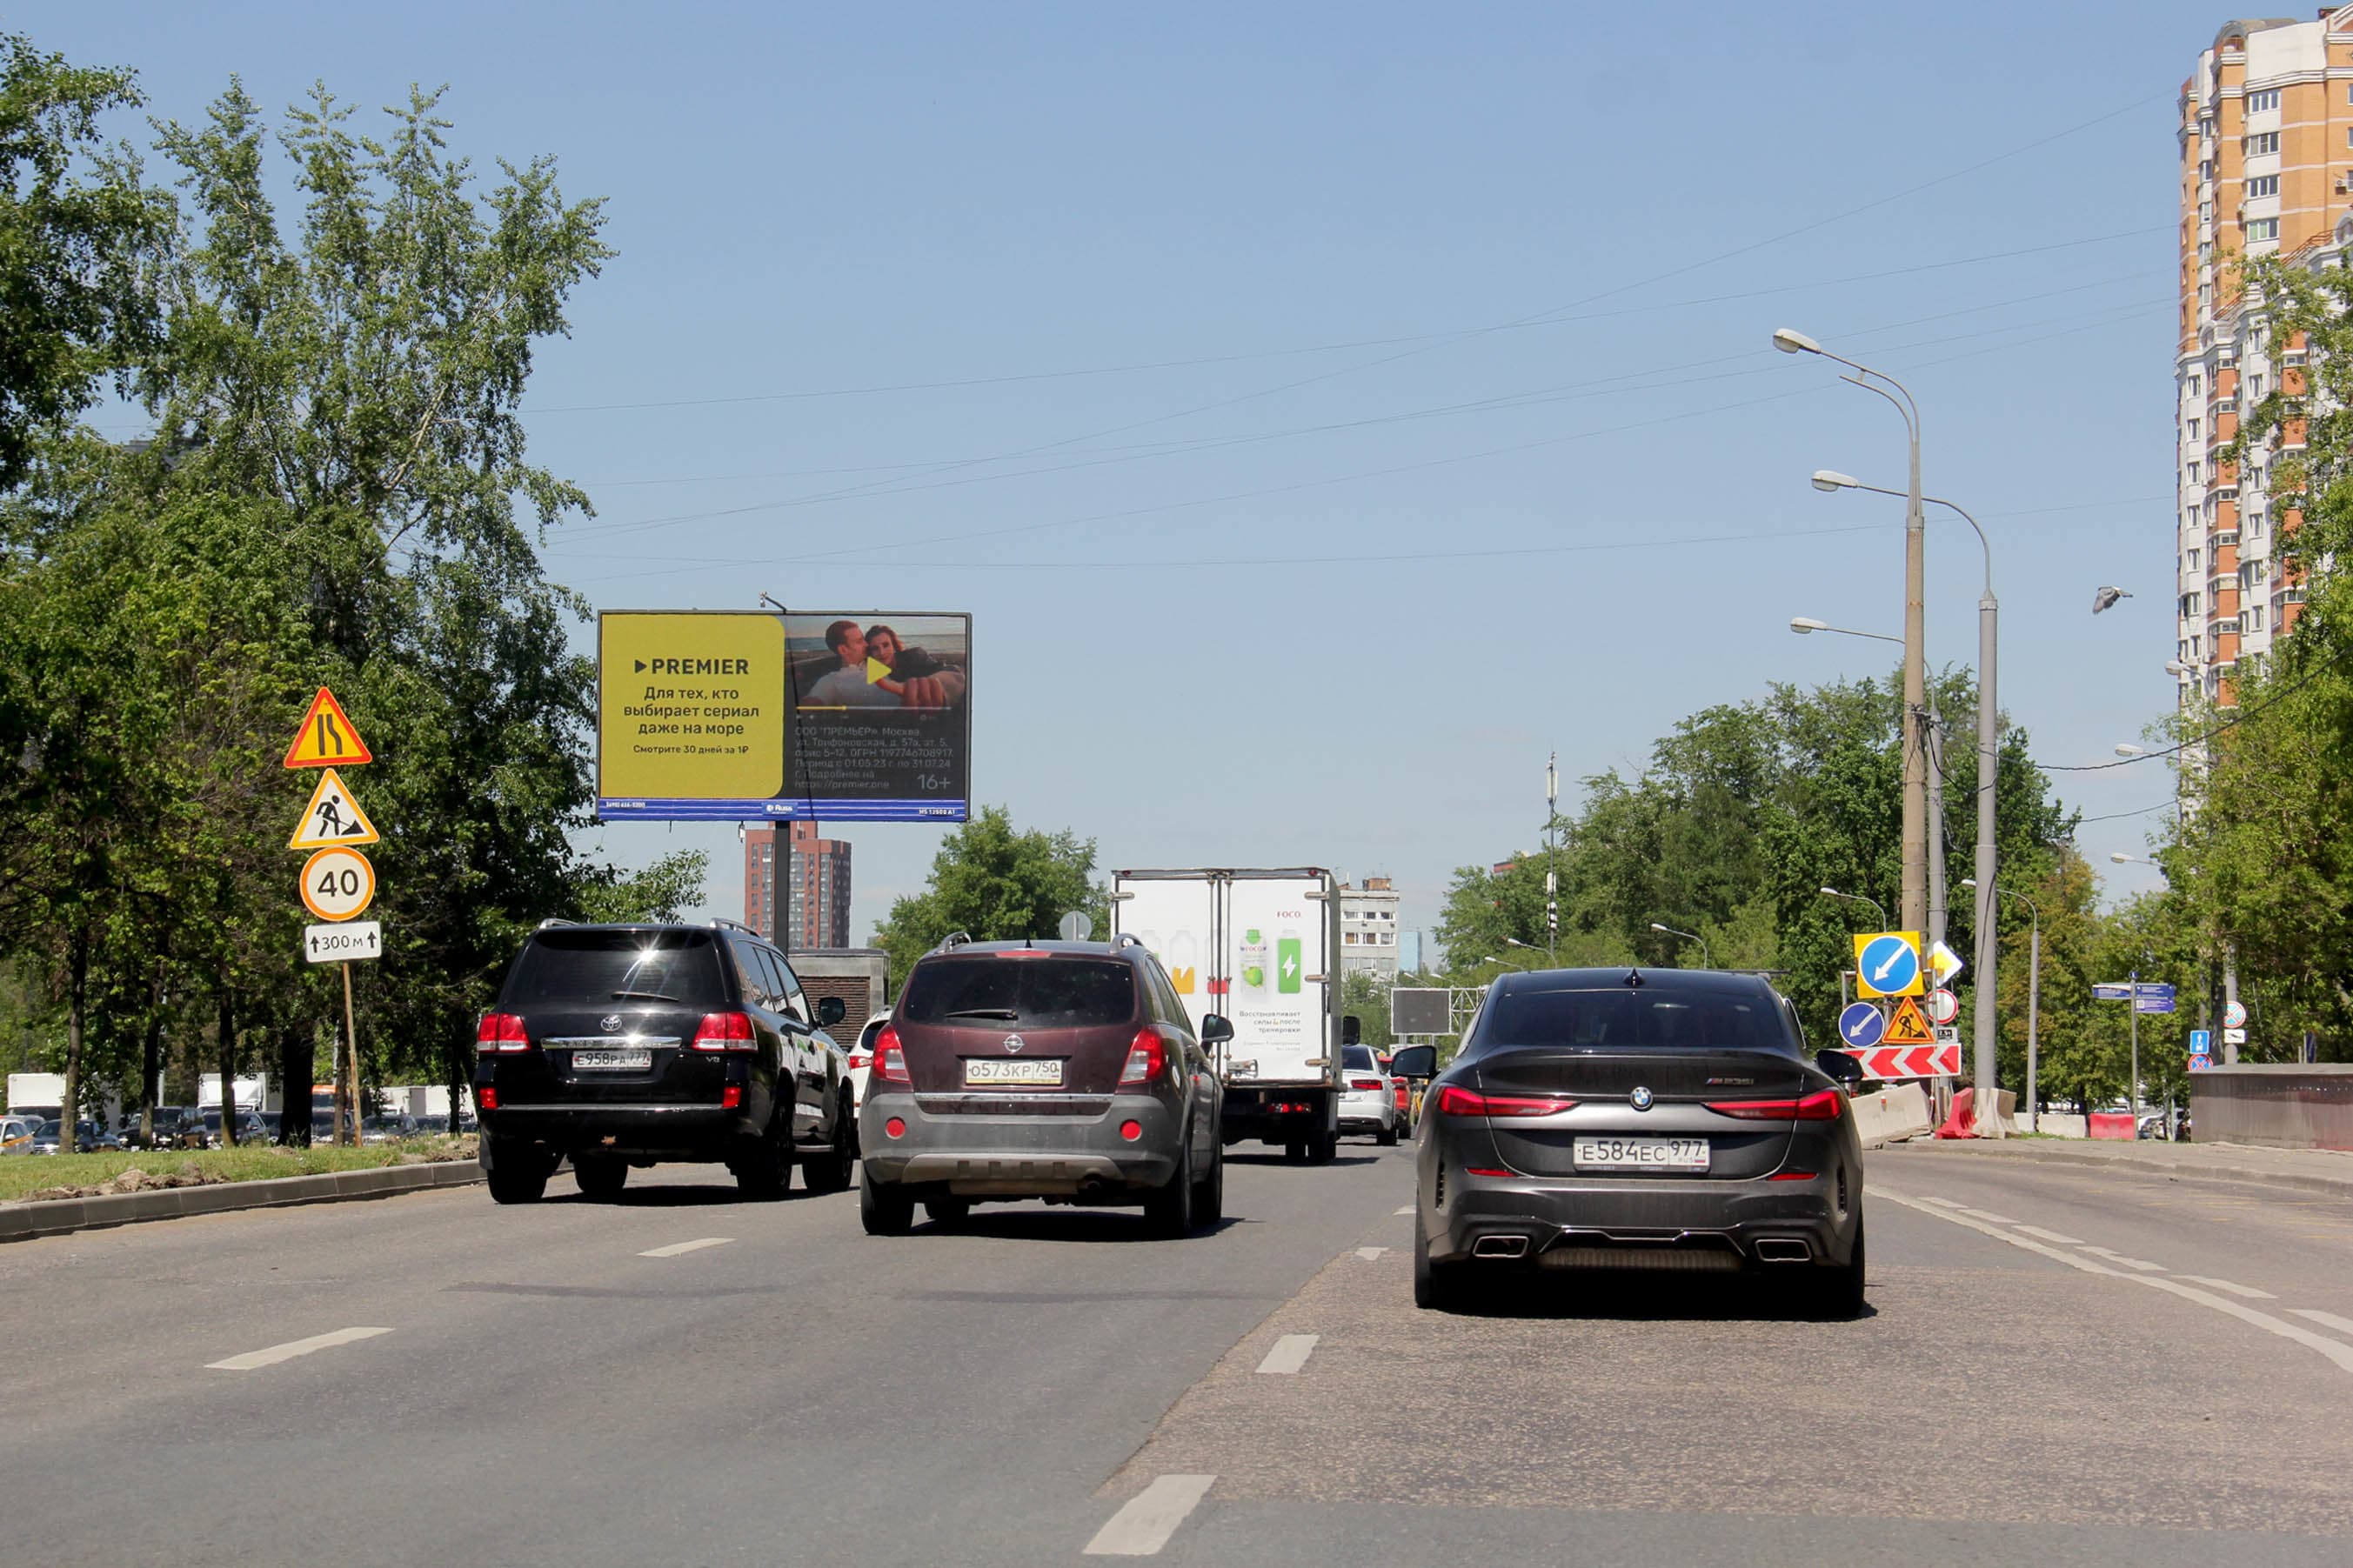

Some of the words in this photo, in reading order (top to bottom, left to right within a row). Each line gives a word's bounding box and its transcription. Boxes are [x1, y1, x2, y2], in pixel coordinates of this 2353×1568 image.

[652, 658, 749, 675] PREMIER
[644, 686, 674, 700] Для
[678, 690, 708, 700] тех,
[712, 690, 739, 699] кто
[624, 704, 699, 719] выбирает
[704, 706, 759, 719] сериал
[638, 724, 679, 735] даже
[683, 724, 702, 734] на
[705, 724, 745, 737] море
[794, 726, 817, 736] ООО
[632, 744, 682, 754] Смотрите
[699, 745, 722, 754] дней
[850, 748, 878, 757] ОГРН
[918, 774, 952, 790] 16+
[317, 868, 359, 897] 40
[322, 934, 350, 951] 300
[352, 937, 364, 948] м
[1035, 1062, 1058, 1073] 750
[1670, 1140, 1703, 1157] 977
